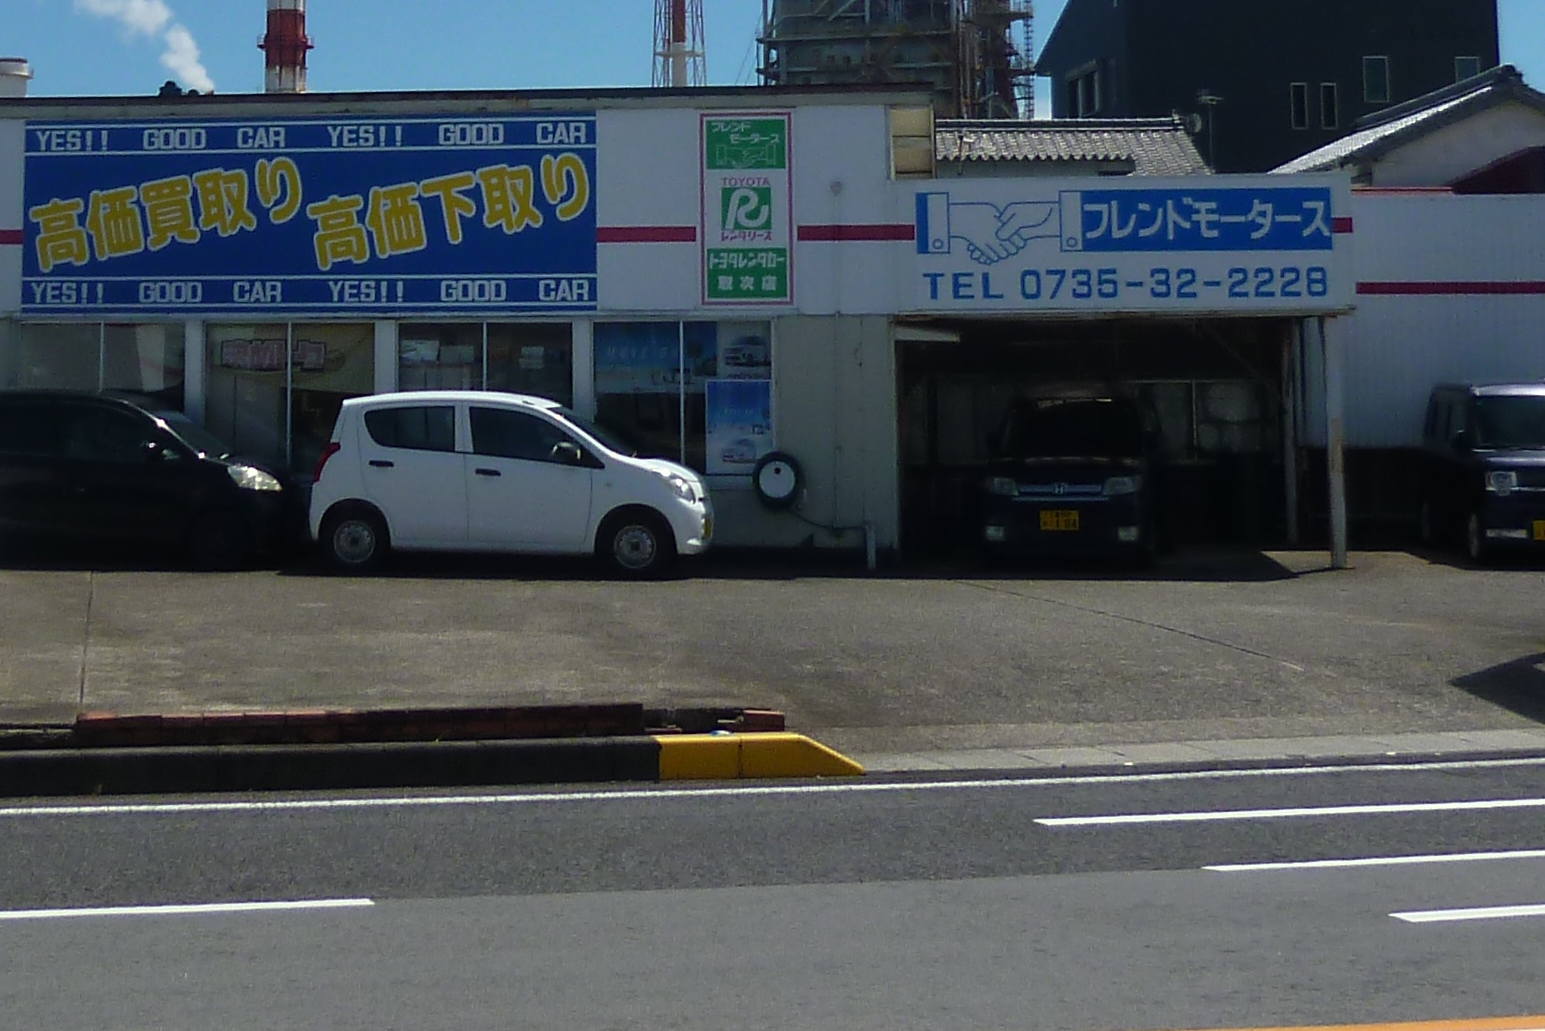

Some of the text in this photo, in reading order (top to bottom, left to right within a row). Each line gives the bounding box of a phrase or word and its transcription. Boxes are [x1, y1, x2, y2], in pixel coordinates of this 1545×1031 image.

[36, 121, 587, 152] YES!! GOOD CAR YES!! GOOD CAR
[711, 121, 751, 133] フレンド
[721, 177, 771, 187] TOYOTA
[28, 152, 590, 273] 高価買取り 高価下取り
[1083, 197, 1331, 241] フレンドモータース
[31, 279, 590, 305] YES!! GOOD CAR YES!! GOOD CAR
[923, 266, 1328, 300] TEL 0735-32-2228
